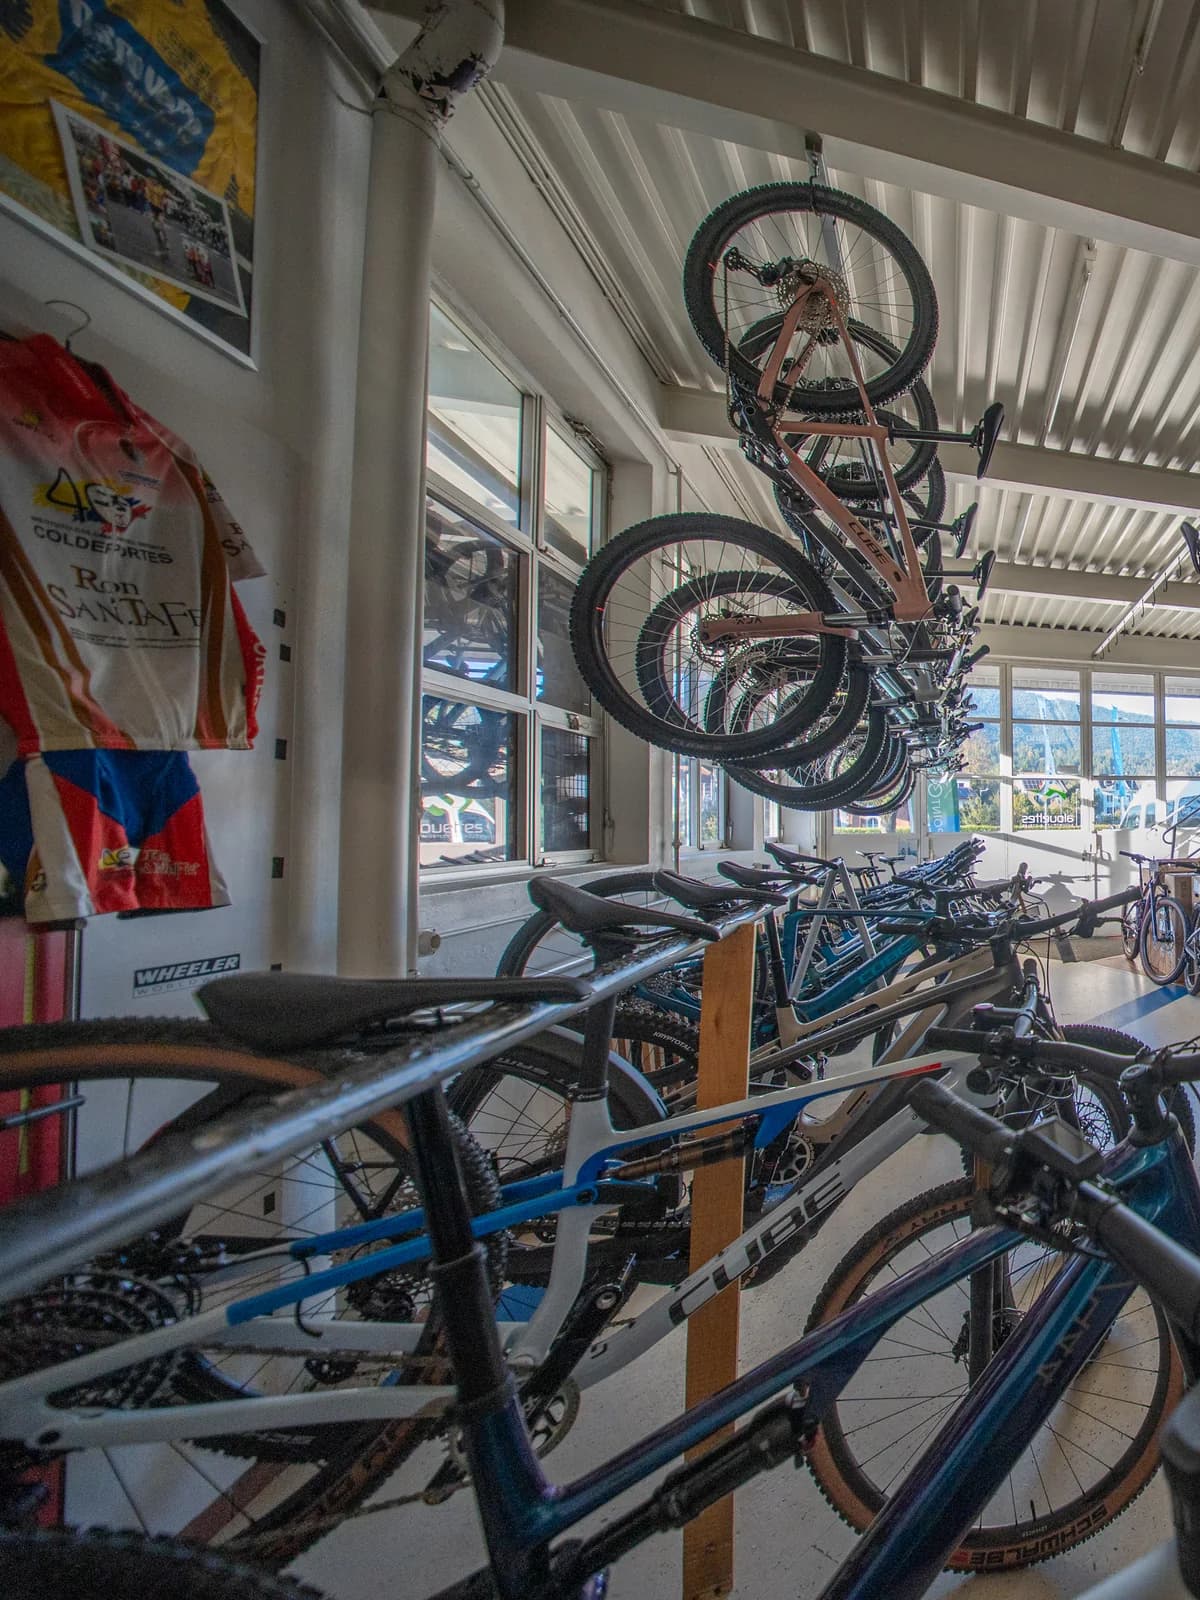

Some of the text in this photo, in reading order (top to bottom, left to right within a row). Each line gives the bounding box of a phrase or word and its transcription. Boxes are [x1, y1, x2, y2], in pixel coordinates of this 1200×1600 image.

[848, 521, 891, 565] CUBE
[135, 955, 240, 986] WHEELER
[668, 1172, 847, 1327] CUBE
[969, 1503, 1109, 1566] SCHWALBE
